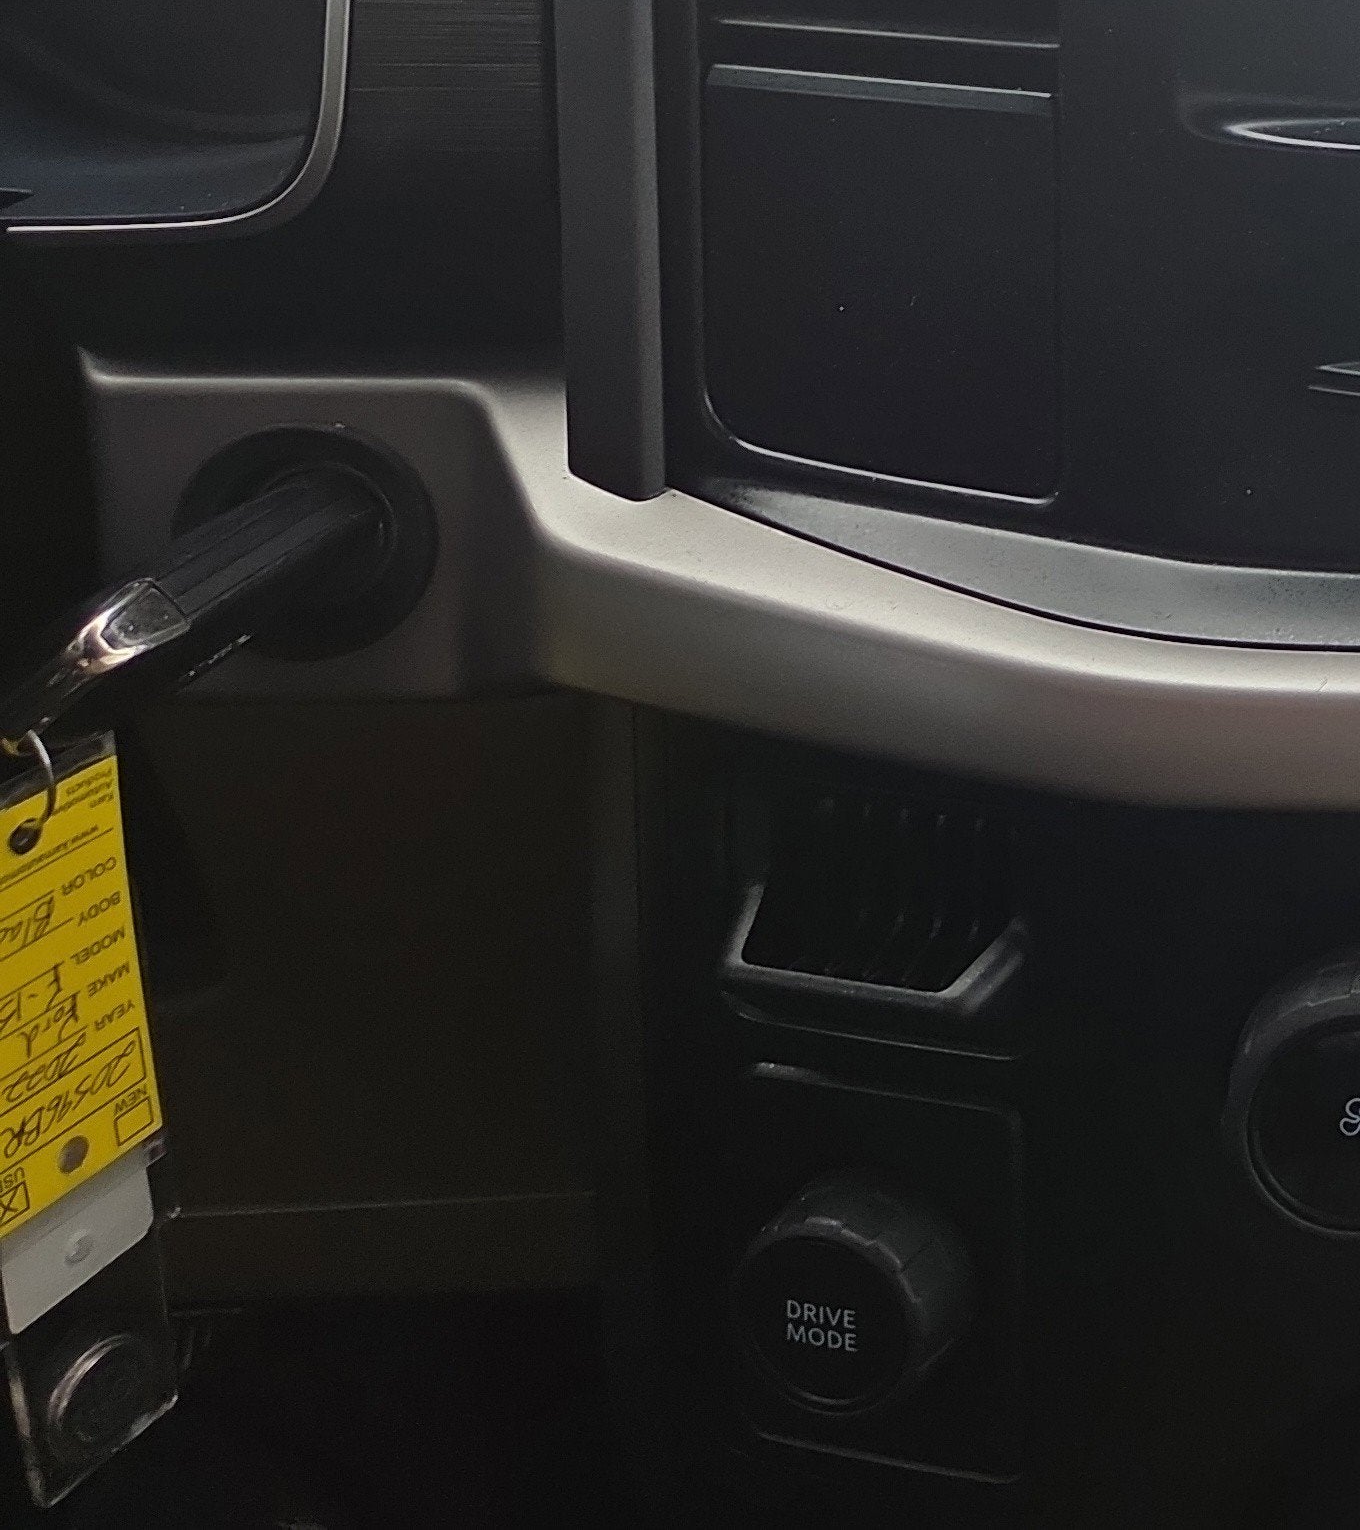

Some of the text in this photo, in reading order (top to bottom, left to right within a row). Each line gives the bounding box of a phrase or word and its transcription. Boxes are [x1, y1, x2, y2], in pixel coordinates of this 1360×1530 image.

[61, 856, 117, 896] COLOR
[77, 890, 121, 928] BODY
[69, 926, 125, 965] MODEL
[87, 961, 131, 999] MAKE
[94, 999, 136, 1032] YEAR
[113, 1083, 148, 1117] NEW
[786, 1299, 857, 1329] DRIVE
[786, 1322, 858, 1352] MODE
